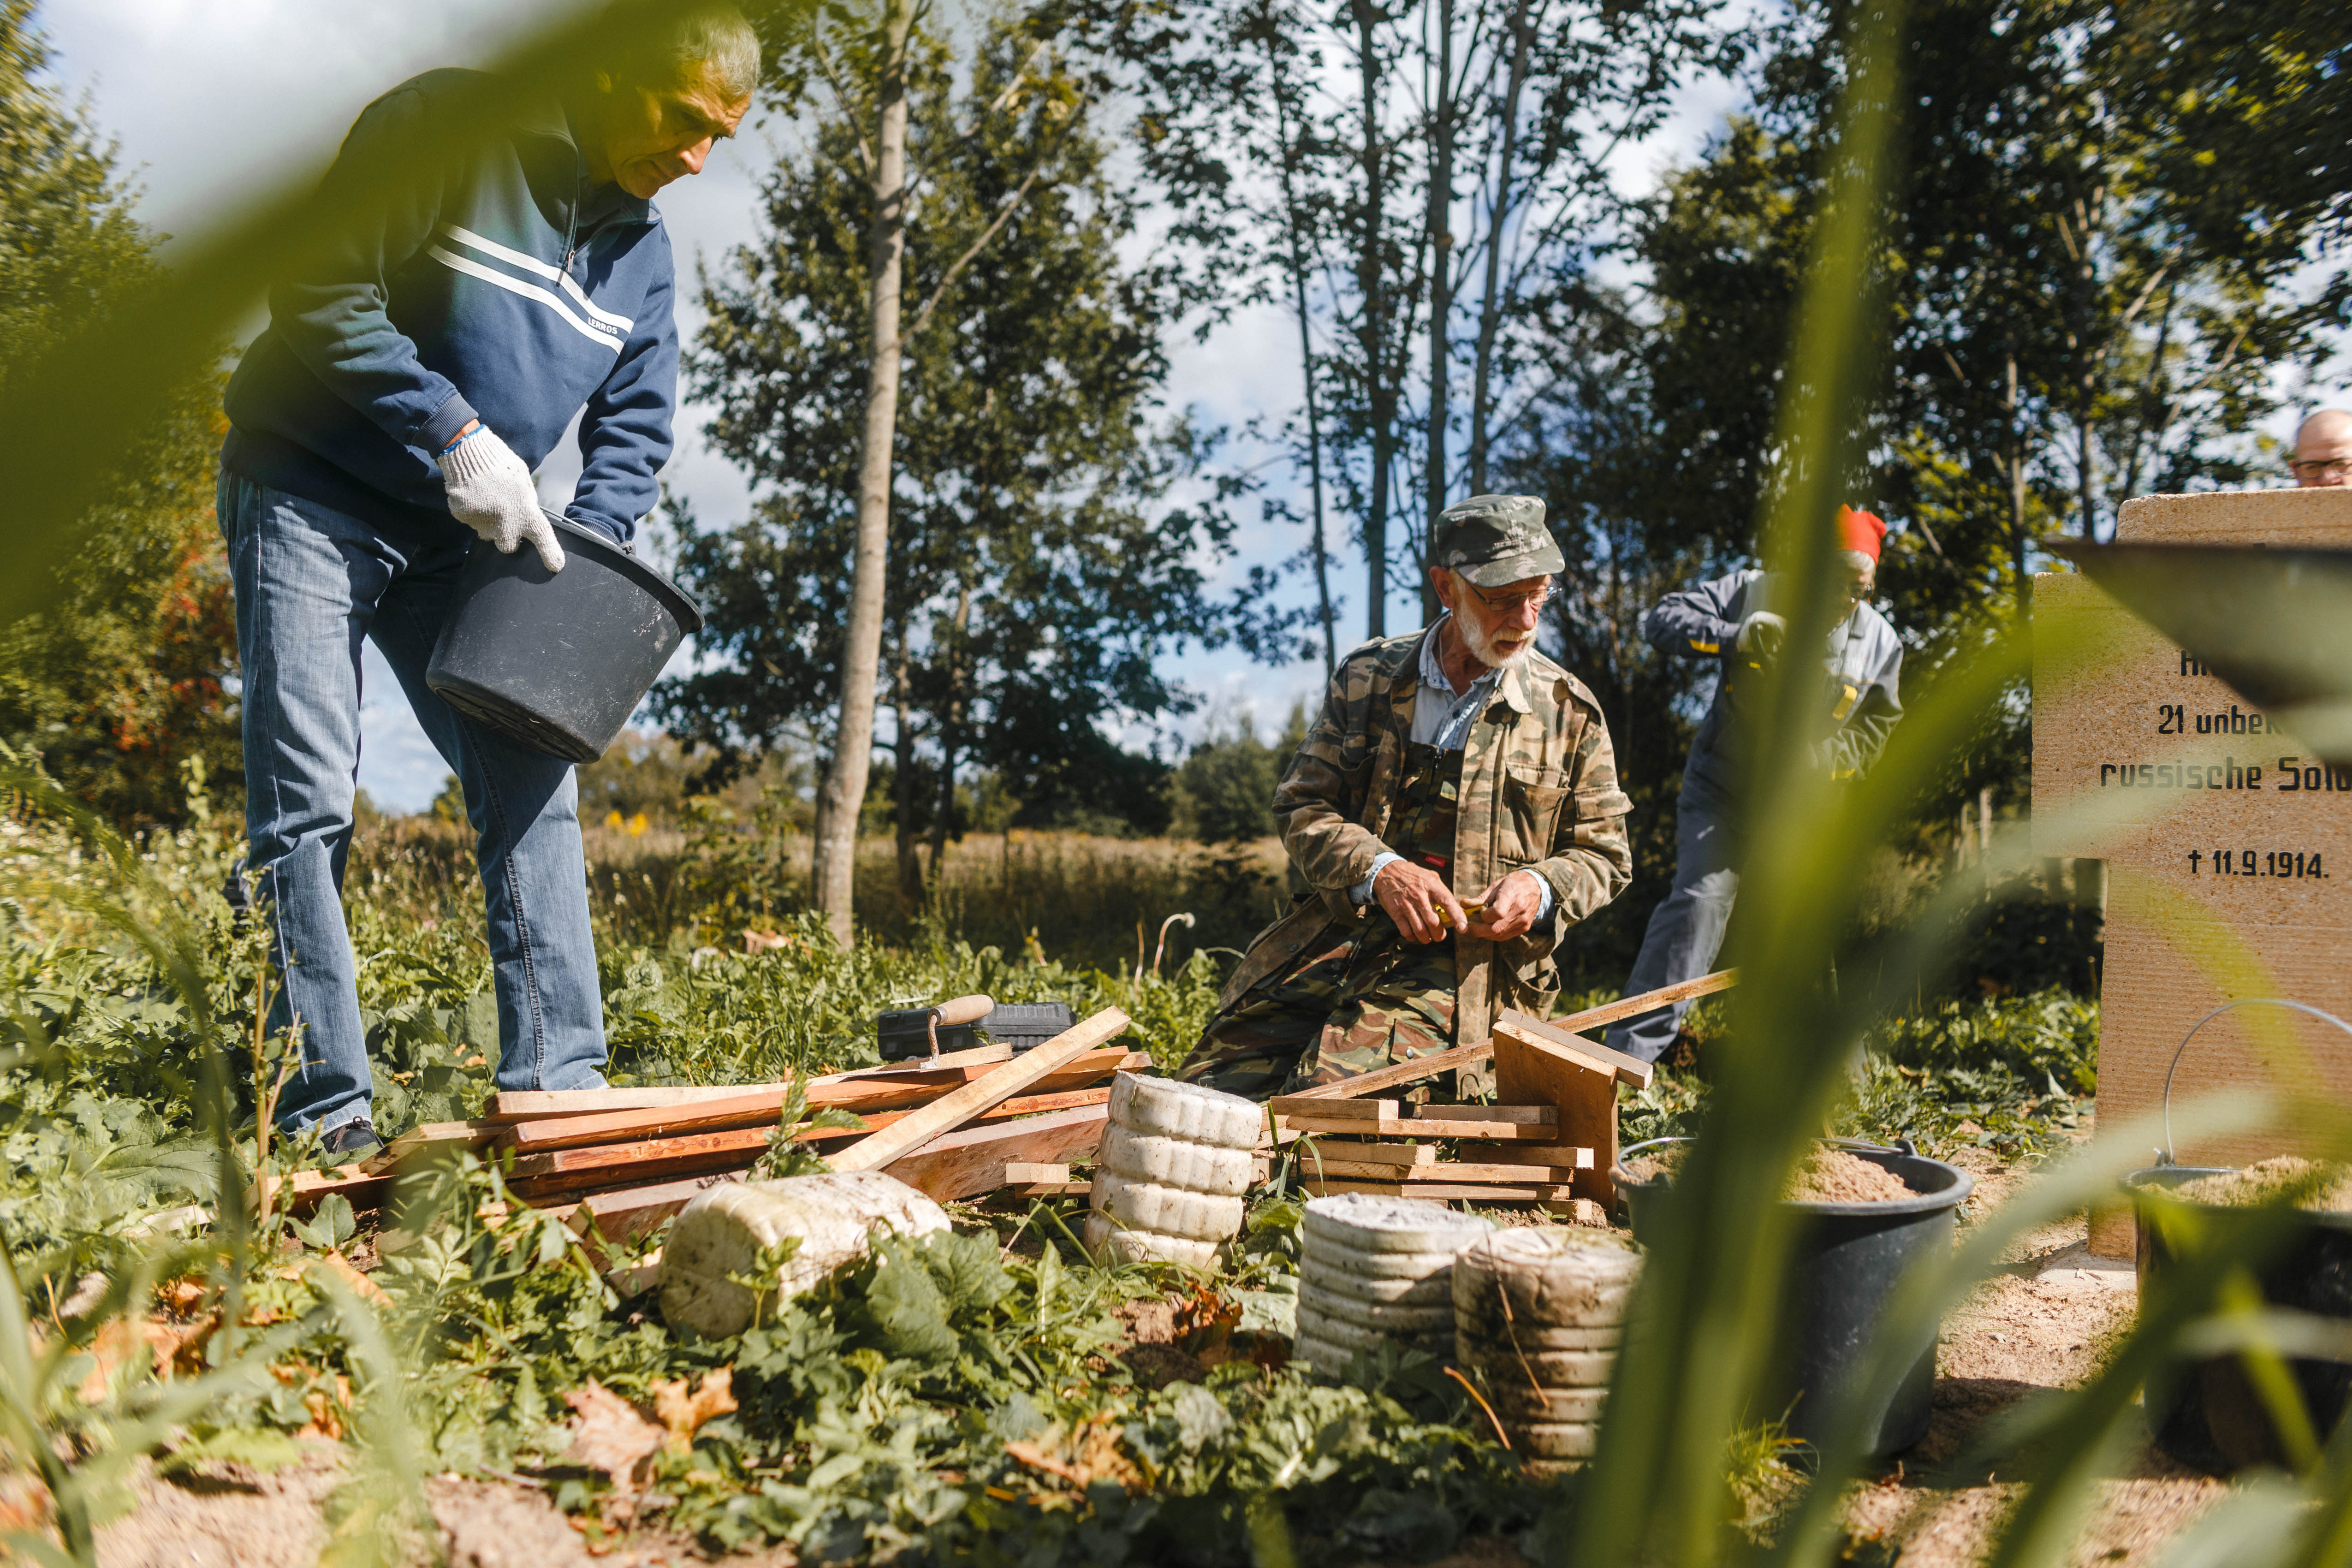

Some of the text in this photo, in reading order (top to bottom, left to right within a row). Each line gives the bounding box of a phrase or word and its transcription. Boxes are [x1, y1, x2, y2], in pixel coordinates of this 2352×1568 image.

[588, 317, 618, 335] LERROS
[2158, 704, 2184, 734] 21
[2101, 756, 2262, 790] russische
[2213, 850, 2329, 878] 11.9.1914.
